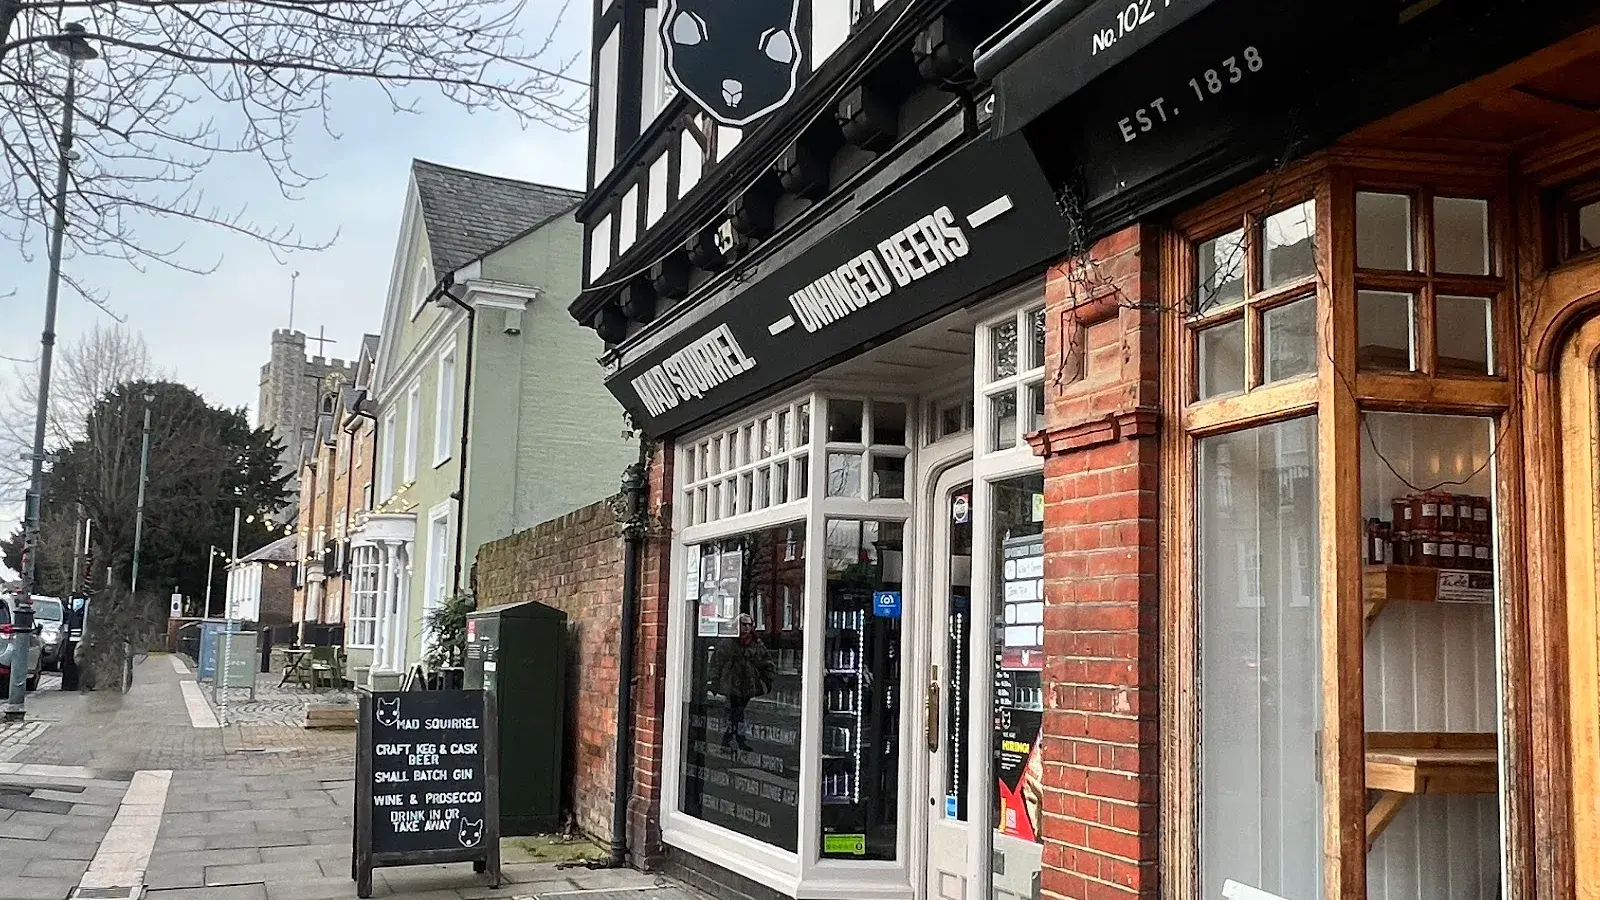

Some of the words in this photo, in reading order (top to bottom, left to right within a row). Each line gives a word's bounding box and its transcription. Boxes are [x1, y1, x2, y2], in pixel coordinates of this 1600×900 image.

[1117, 98, 1180, 143] EST.
[1188, 45, 1264, 102] 1838
[788, 249, 893, 334] UNHINGED
[877, 205, 971, 288] BEERS
[630, 366, 676, 418] MAD
[662, 322, 757, 401] SQUIRREL
[396, 718, 420, 730] MAD
[425, 718, 479, 730] SQUIRREL
[375, 743, 412, 755] CRAFT
[416, 743, 436, 755] KEG
[439, 744, 447, 755] &
[450, 743, 478, 755] CASK
[408, 754, 440, 766] BEER
[374, 771, 410, 783] SMALL
[413, 769, 448, 781] BATCH
[452, 769, 473, 780] GIN
[373, 794, 404, 806] WINE
[409, 793, 418, 805] &
[425, 791, 482, 804] PROSECCO
[390, 810, 425, 822] DRINK
[429, 809, 442, 820] IN
[445, 809, 460, 820] OR
[392, 821, 420, 833] TAKE
[424, 819, 452, 831] AWAY
